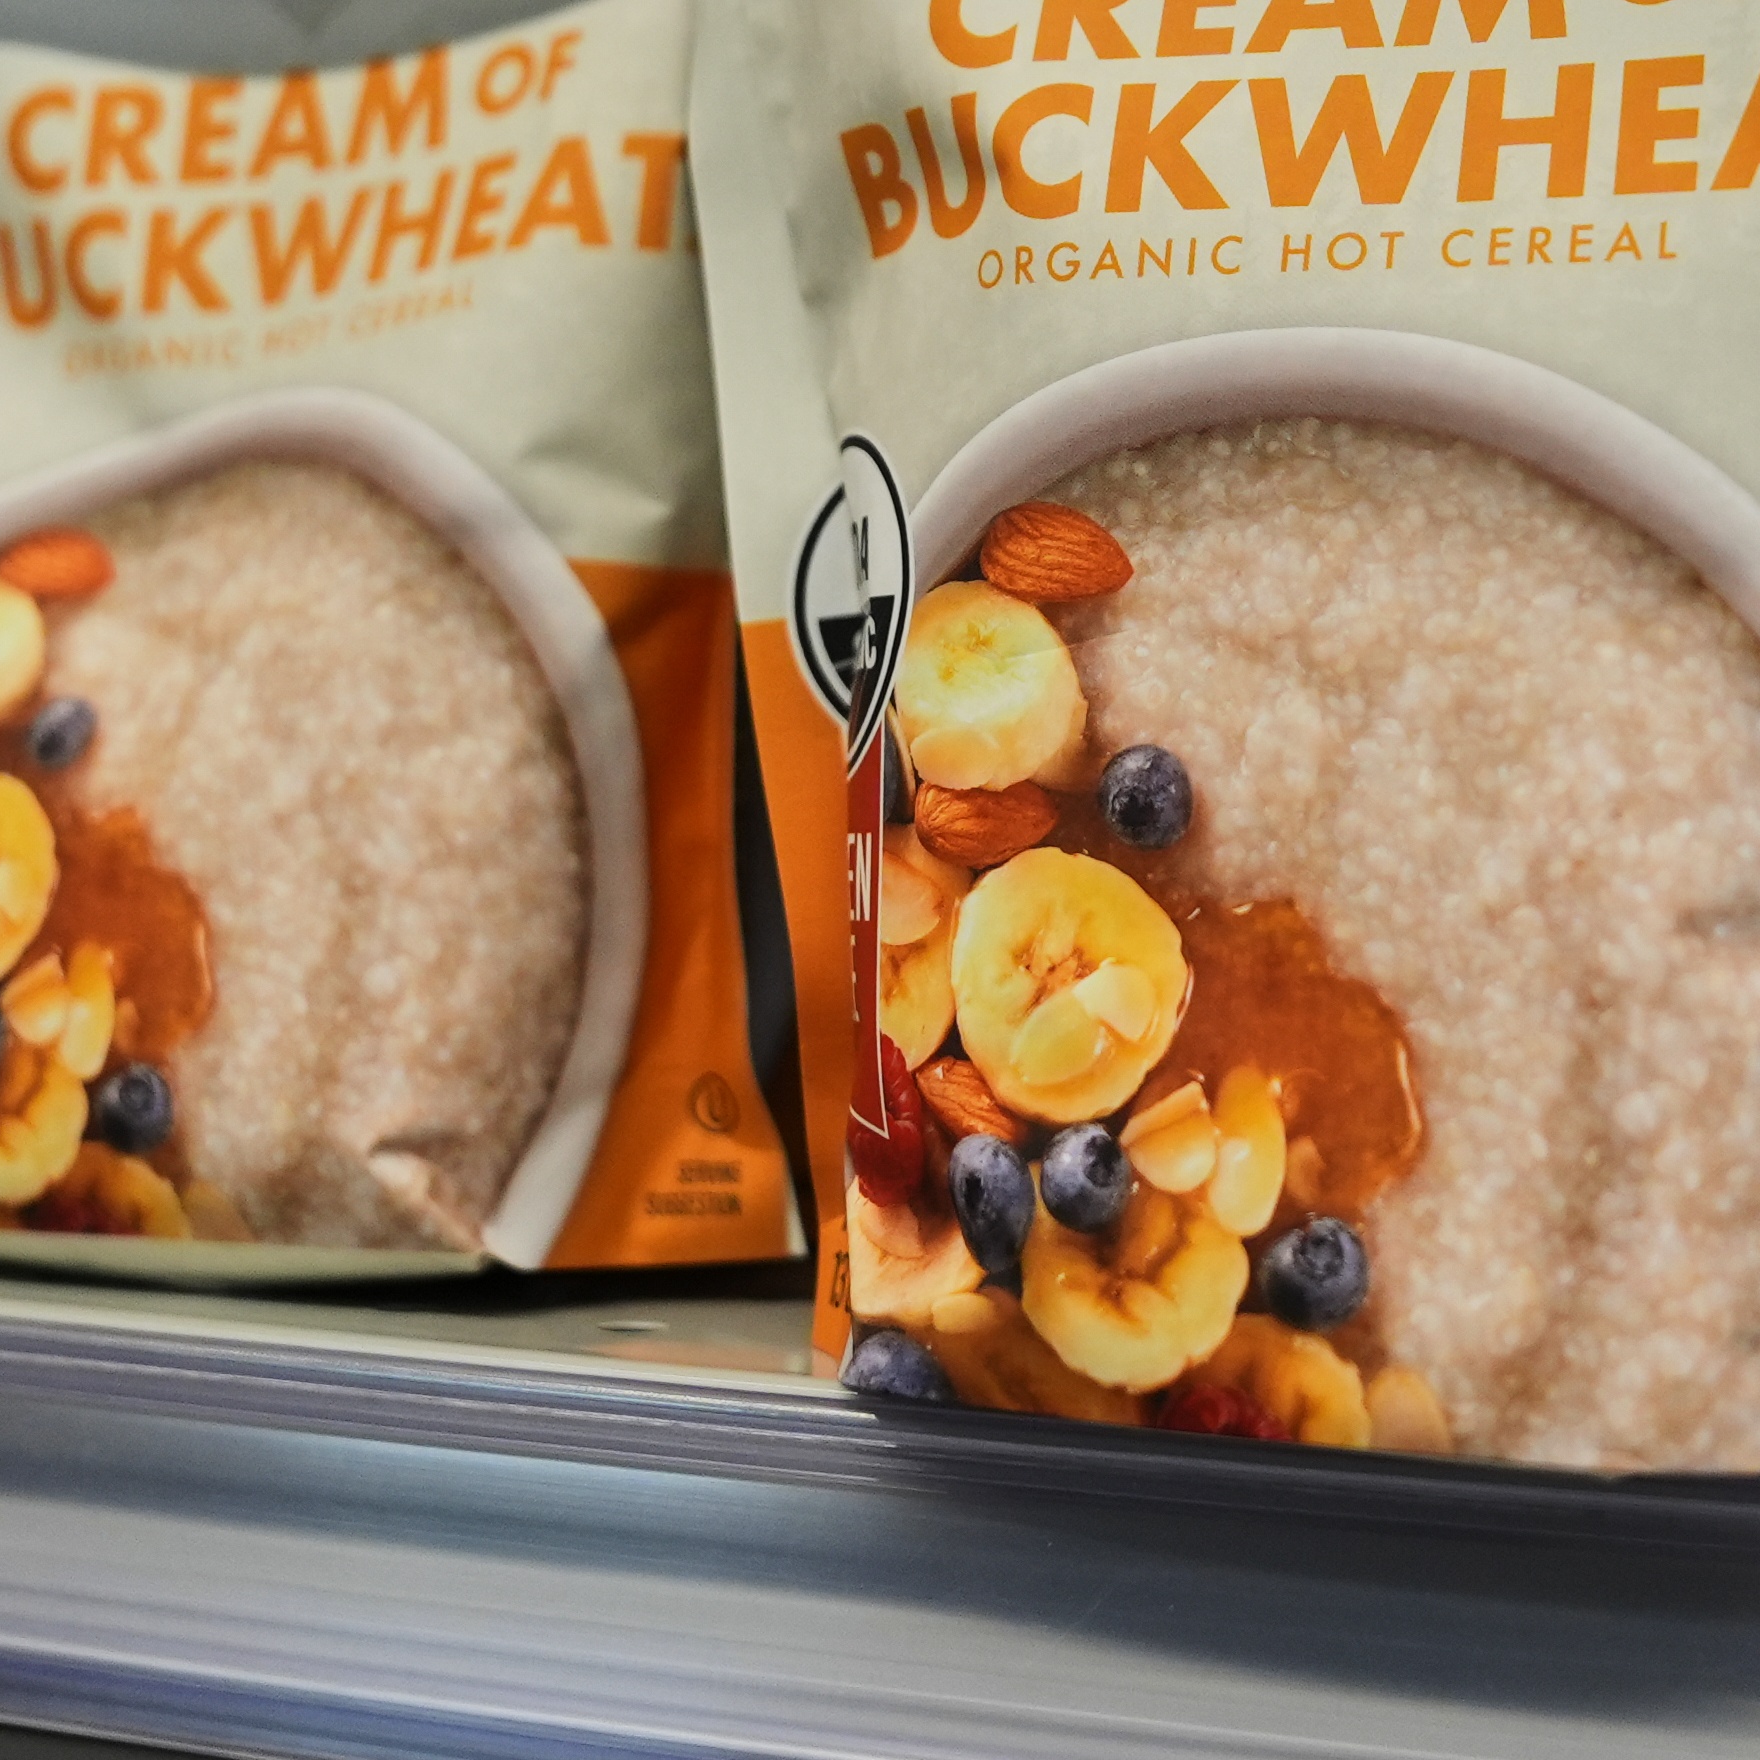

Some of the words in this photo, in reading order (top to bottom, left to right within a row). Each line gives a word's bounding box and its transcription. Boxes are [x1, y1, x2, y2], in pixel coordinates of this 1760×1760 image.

[5, 42, 451, 197] CREAM
[472, 28, 585, 119] OF
[977, 234, 1244, 290] ORGANIC
[1279, 229, 1408, 275] HOT
[1441, 220, 1680, 269] CEREAL
